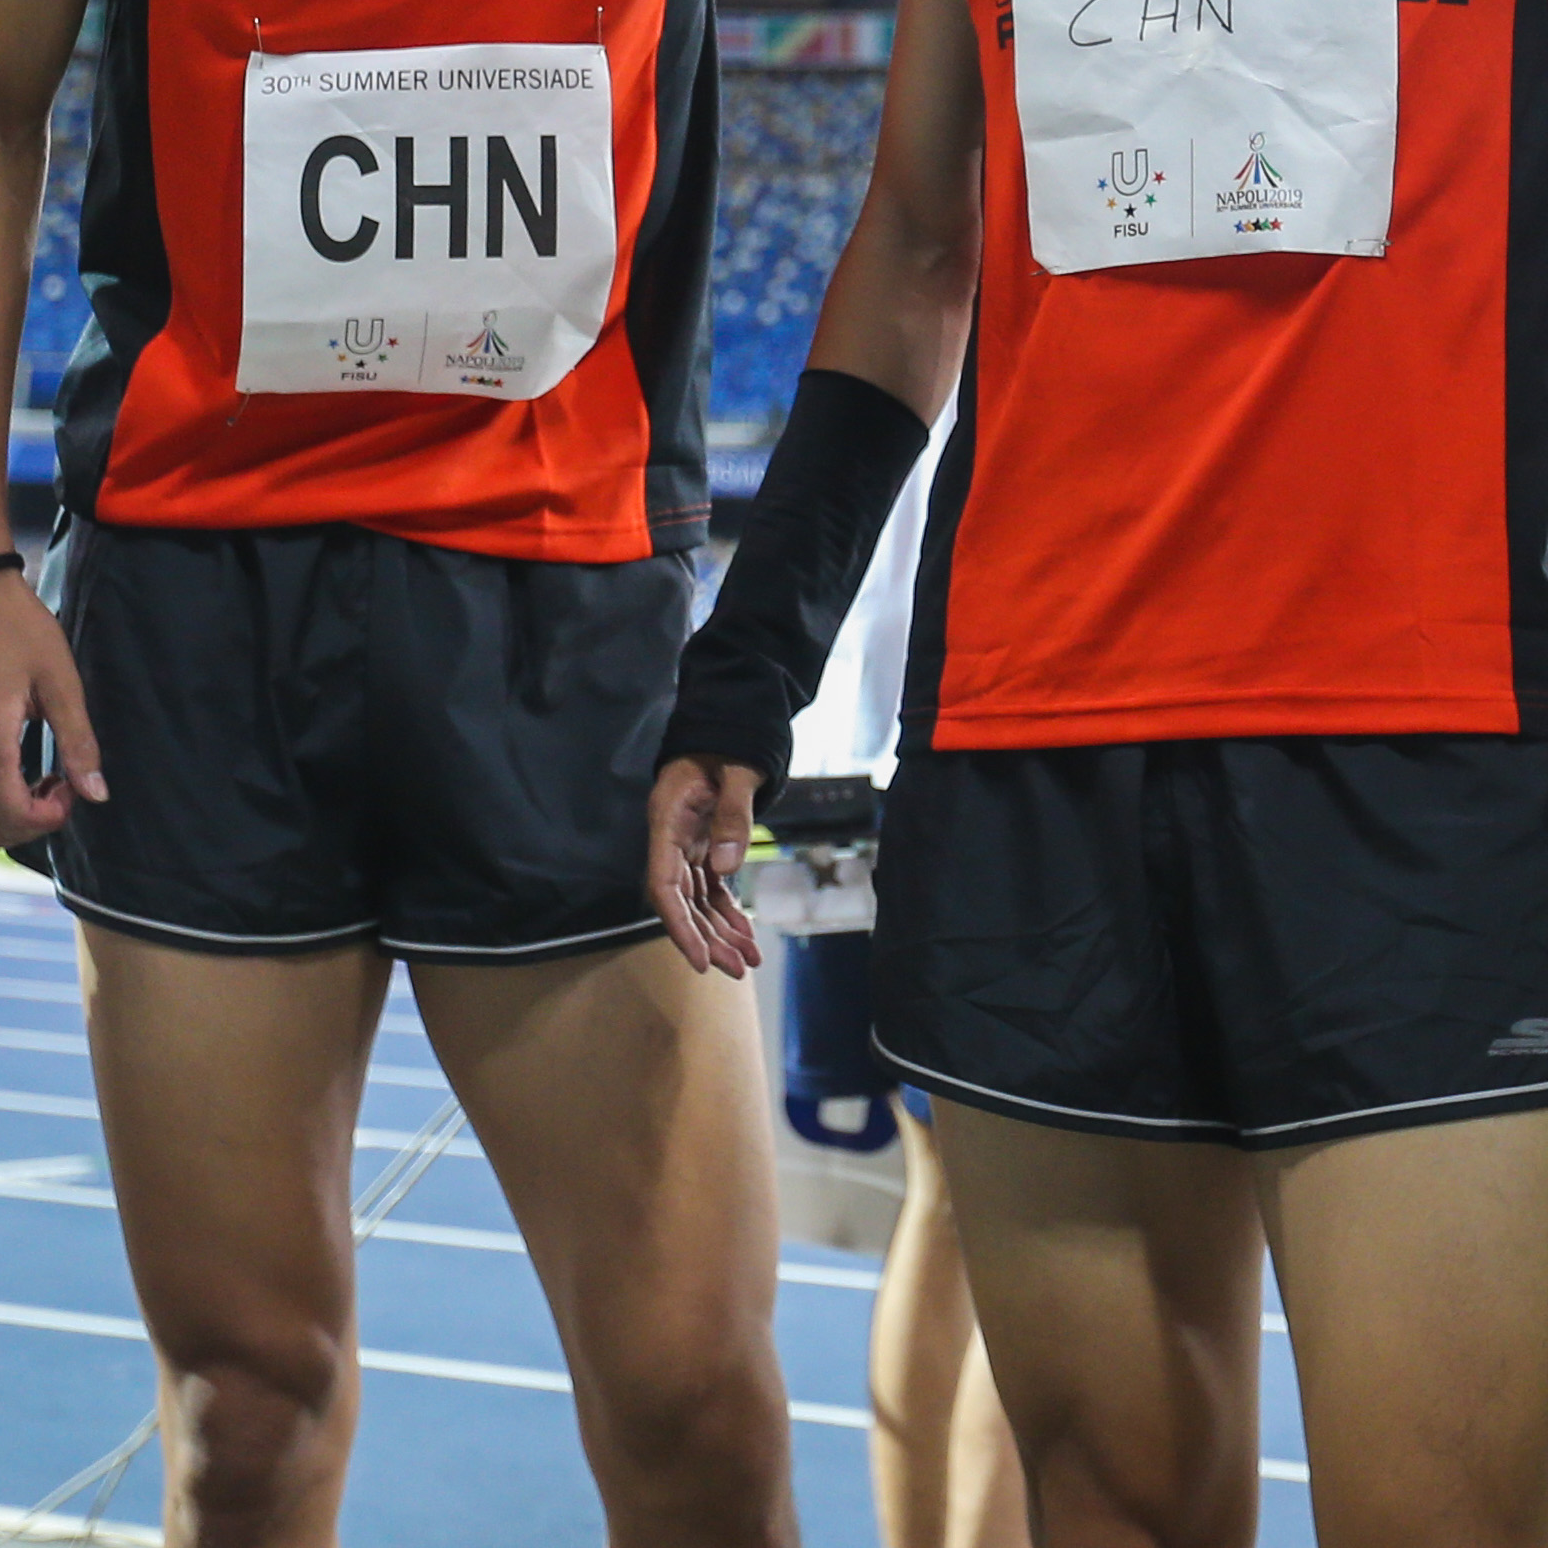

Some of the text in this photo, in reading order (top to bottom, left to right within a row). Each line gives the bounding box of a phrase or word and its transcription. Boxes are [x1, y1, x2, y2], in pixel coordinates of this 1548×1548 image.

[261, 68, 594, 95] 30TH SUMMER UNIVERSIADE
[300, 134, 558, 263] CHN
[1113, 222, 1149, 239] FISU
[341, 371, 377, 381] FISU
